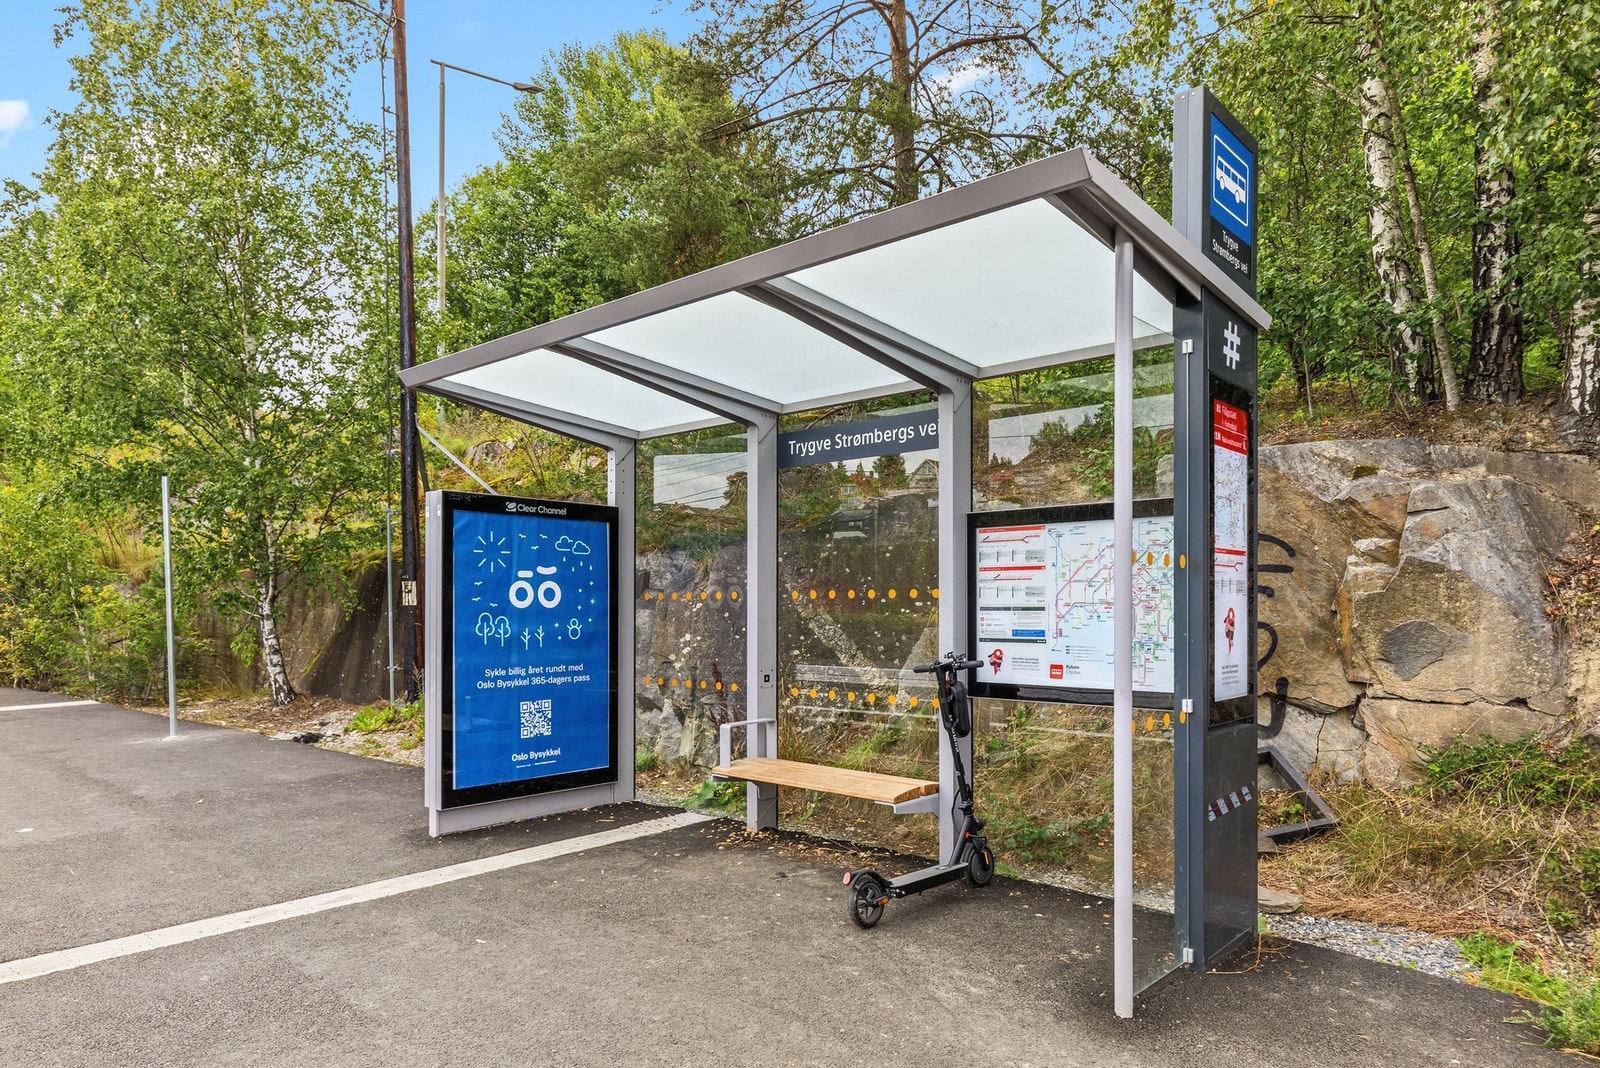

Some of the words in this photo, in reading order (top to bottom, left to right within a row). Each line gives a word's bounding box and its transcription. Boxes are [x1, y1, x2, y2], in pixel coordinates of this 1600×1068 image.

[1222, 229, 1239, 252] Trygve
[1240, 262, 1248, 274] vei
[788, 437, 831, 457] Trygve
[835, 426, 915, 449] Strømbergs
[517, 503, 537, 513] Clear
[537, 505, 567, 516] Channel
[484, 668, 506, 678] Sykle
[508, 666, 526, 676] billig
[528, 665, 543, 674] året
[545, 664, 566, 673] rundt
[568, 663, 583, 671] med
[476, 680, 495, 689] Oslo
[496, 677, 530, 689] Bysykkel
[531, 675, 572, 685] 365-dagers
[573, 674, 591, 683] pass
[511, 753, 529, 762] Oslo
[529, 747, 561, 760] Bysykkel
